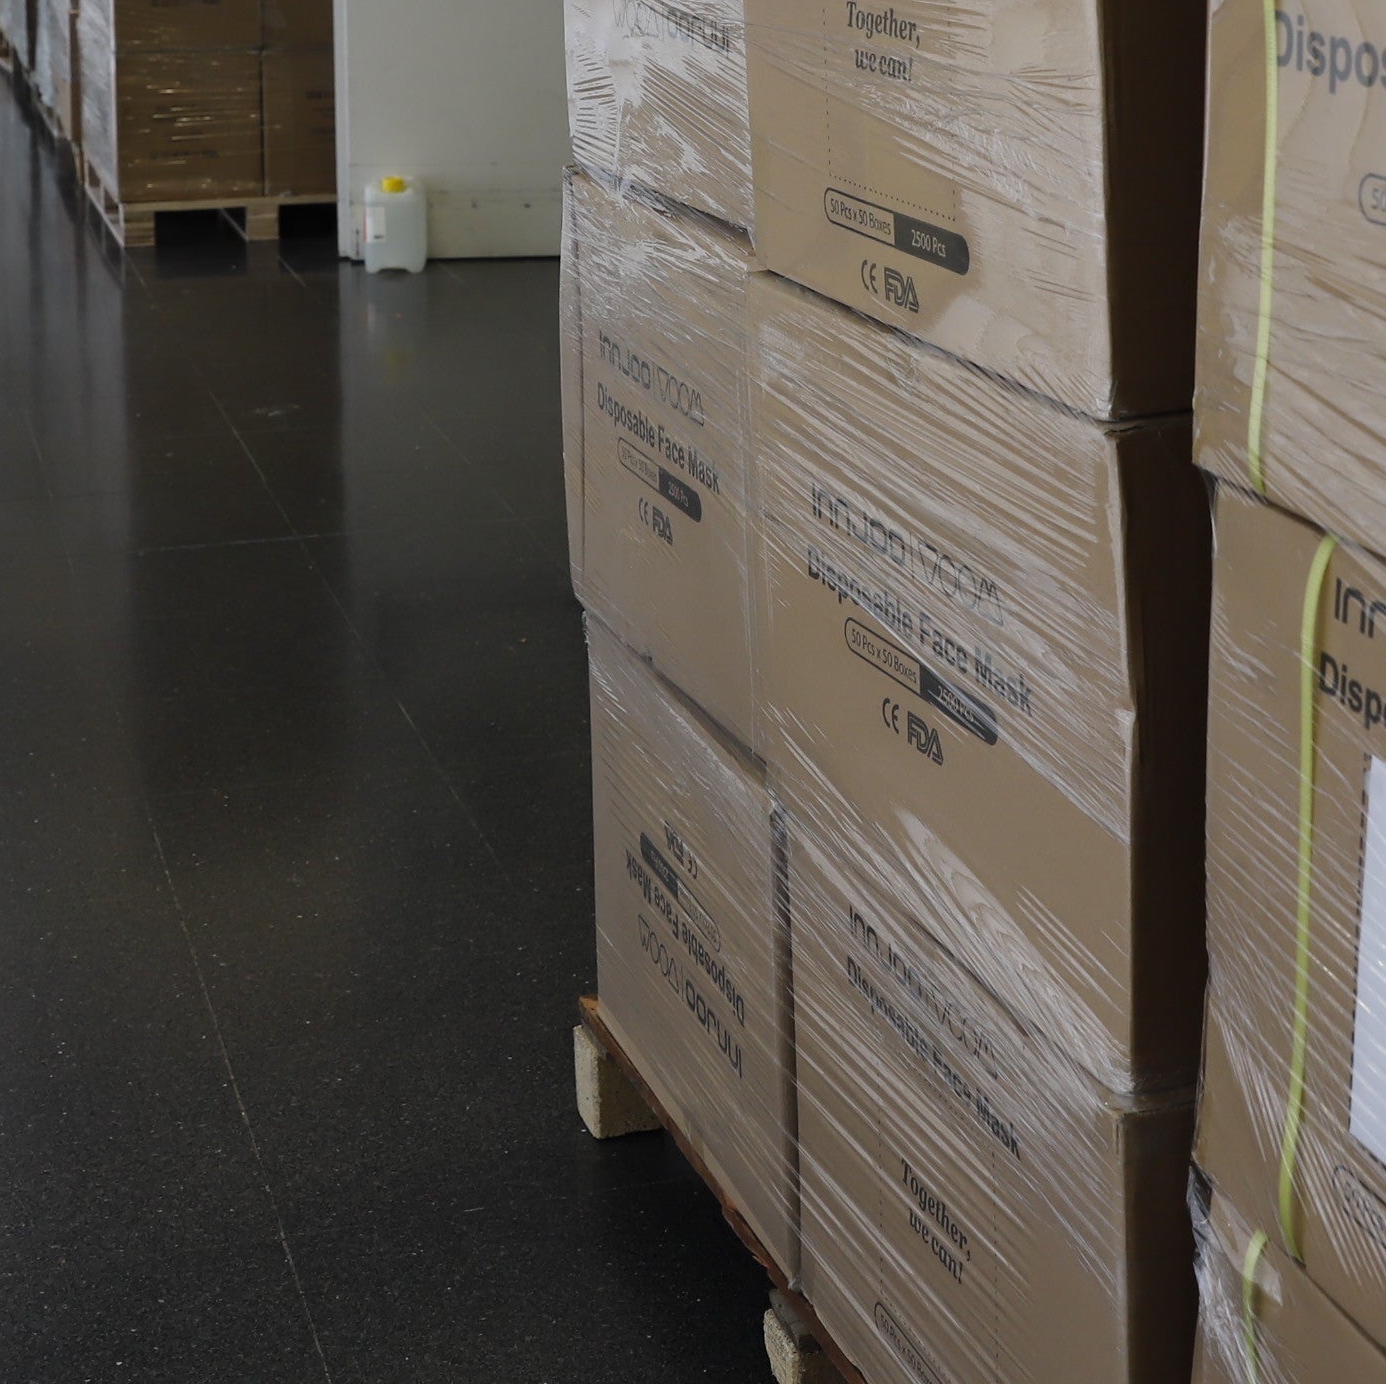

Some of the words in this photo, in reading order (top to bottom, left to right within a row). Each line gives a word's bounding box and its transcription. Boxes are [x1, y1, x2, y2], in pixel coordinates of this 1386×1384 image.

[846, 0, 920, 48] Together,
[855, 49, 877, 75] we
[879, 55, 913, 82] can!
[830, 198, 840, 216] 50
[840, 201, 852, 220] Pcs
[858, 205, 868, 226] 50
[869, 209, 892, 236] Boxes
[911, 229, 931, 251] 2500
[933, 236, 946, 258] Pcs
[883, 266, 920, 314] FDA
[597, 381, 655, 449] Disposable
[657, 424, 685, 470] Face
[688, 445, 720, 495] Mask
[851, 628, 861, 647] 50
[863, 634, 875, 656] Pcs
[883, 647, 892, 667] 50
[895, 657, 917, 684] Boxes
[907, 710, 944, 766] FDA
[626, 848, 653, 905] Mask
[654, 891, 680, 941] Face
[682, 927, 745, 1028] Disposable
[900, 1158, 971, 1263] Together,
[909, 1207, 929, 1246] we
[931, 1233, 963, 1285] can!
